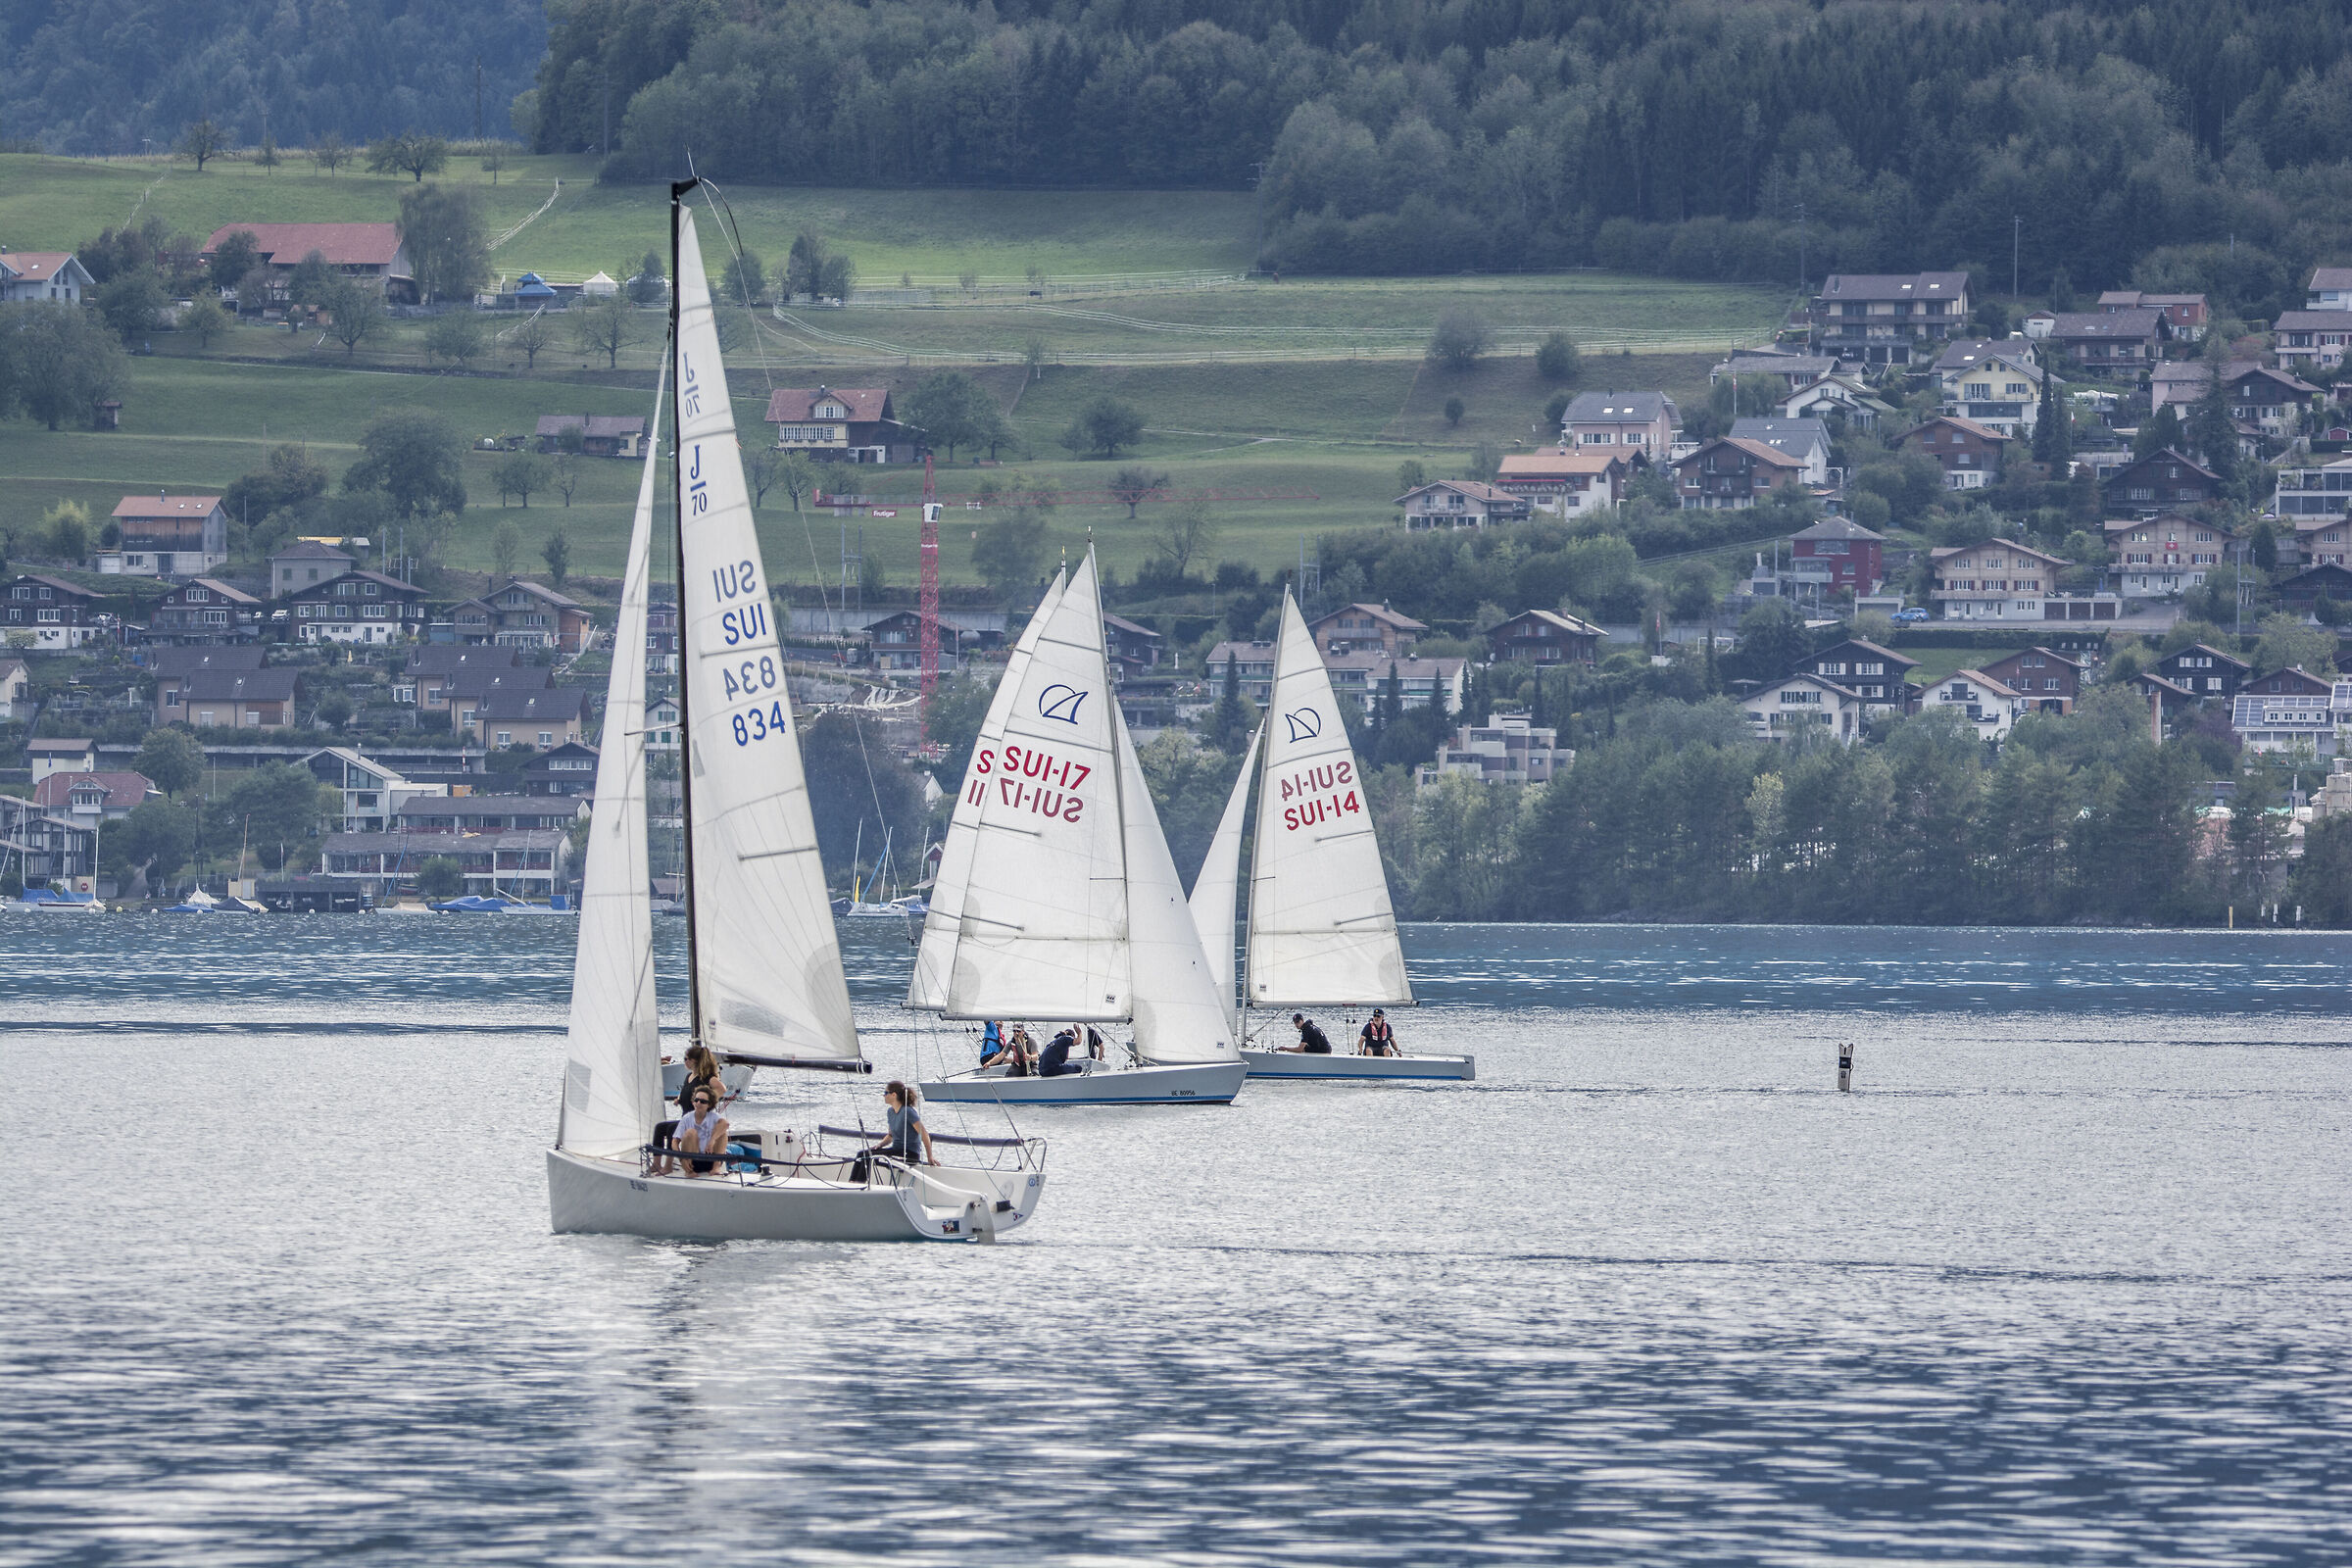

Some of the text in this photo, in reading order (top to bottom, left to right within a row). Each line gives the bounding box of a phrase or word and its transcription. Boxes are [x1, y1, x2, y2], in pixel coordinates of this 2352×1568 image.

[690, 444, 701, 480] J
[691, 492, 708, 516] 70
[873, 510, 896, 518] Frutiger
[722, 603, 767, 646] SUI
[732, 701, 786, 747] 834
[1003, 746, 1092, 791] SUI-17
[1284, 790, 1360, 831] SUI-14
